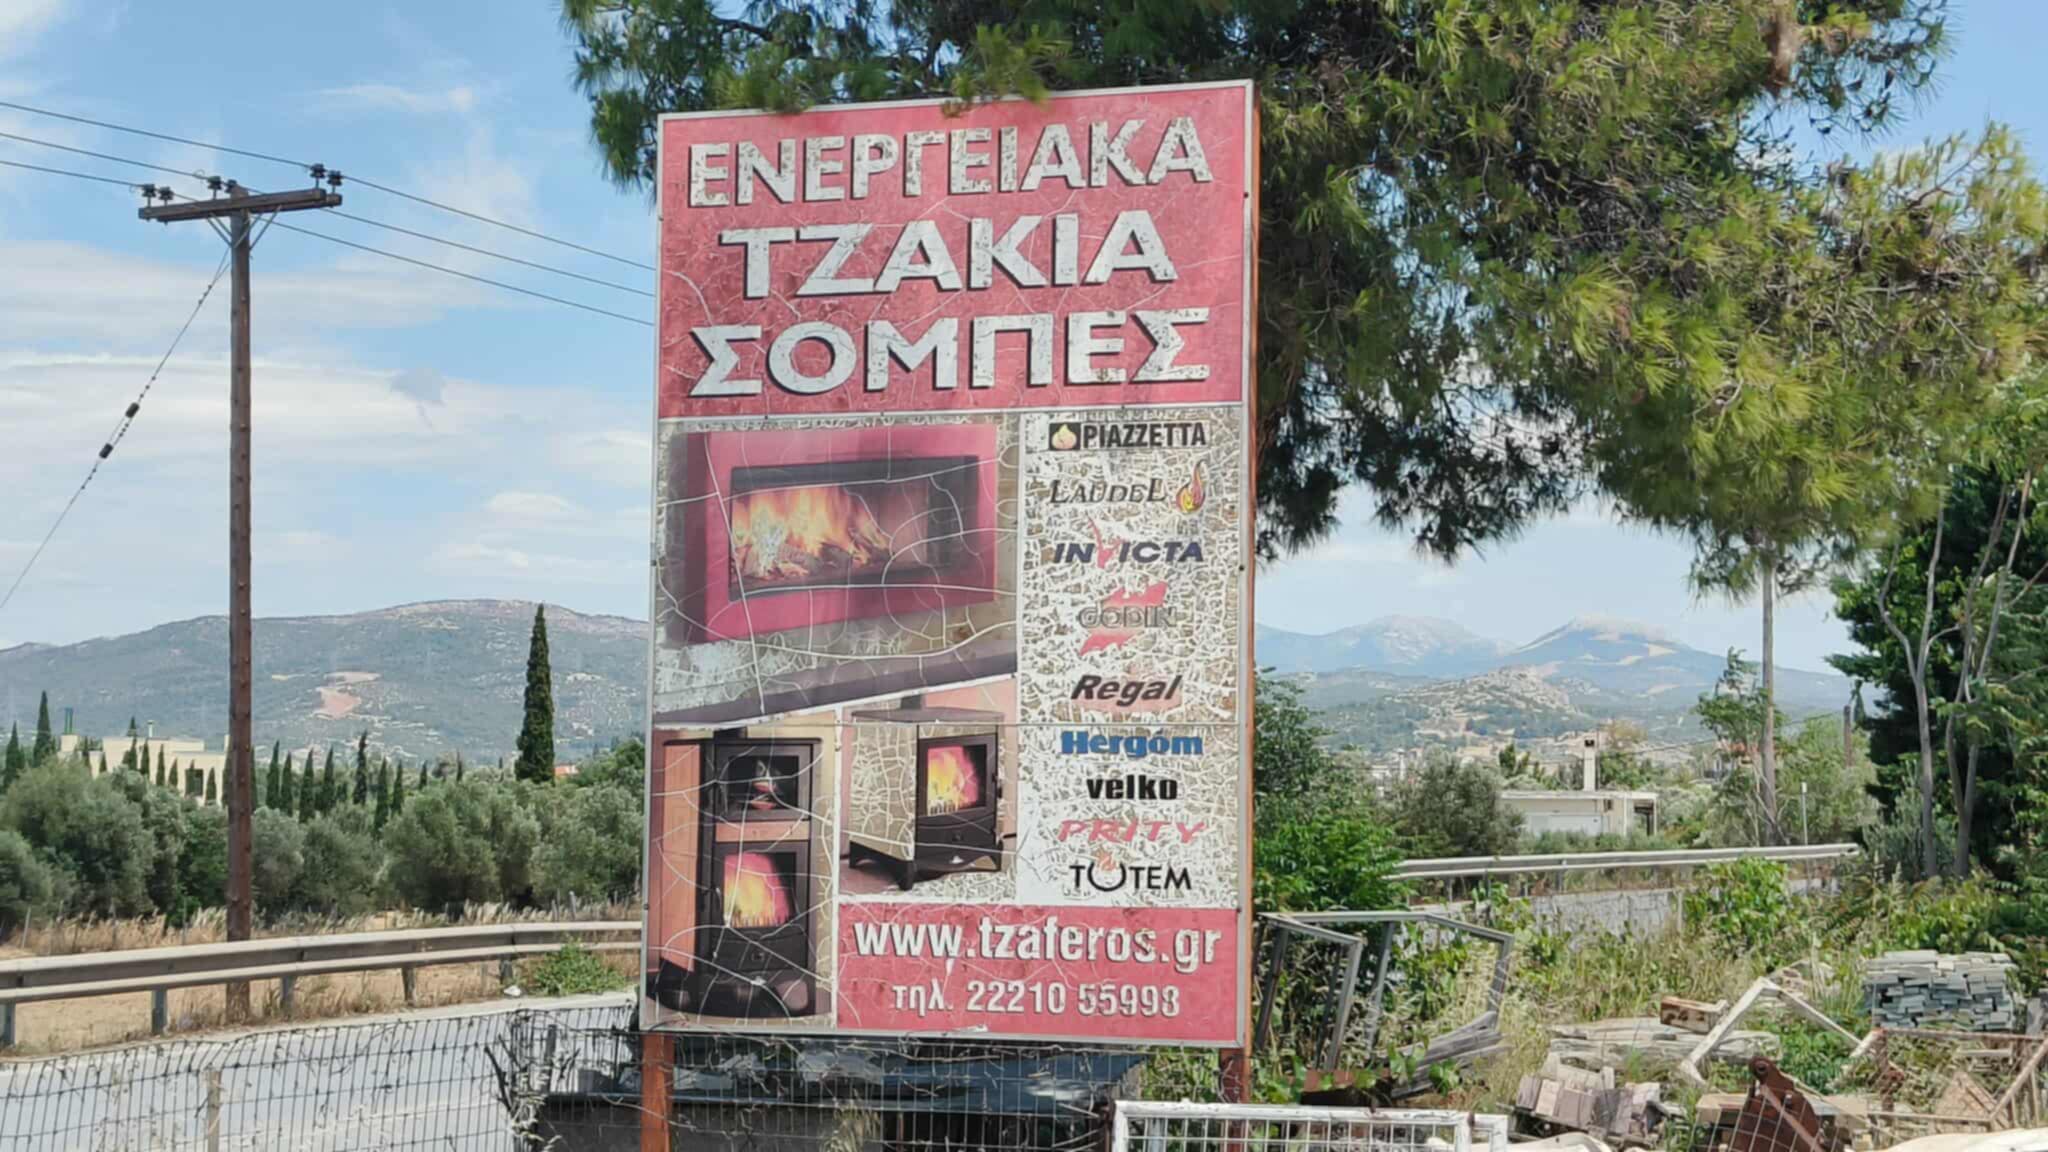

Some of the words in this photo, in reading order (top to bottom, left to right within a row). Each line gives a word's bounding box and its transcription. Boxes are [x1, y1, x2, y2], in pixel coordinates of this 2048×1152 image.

[688, 117, 1214, 208] ΕΝΕΡΓΕΙΑΚΑ
[720, 210, 1178, 299] ΤΖΑΚΙΑ
[690, 308, 1210, 397] ΣΟΜΠΕΣ
[1083, 423, 1206, 449] PIAZZETTA
[1054, 530, 1204, 568] INVICTA
[1071, 675, 1182, 707] Regal
[1060, 729, 1203, 758] Hergóm
[1058, 819, 1205, 844] PRITY
[853, 916, 1222, 974] www.tzaferos.gr
[966, 980, 1067, 1014] 22210
